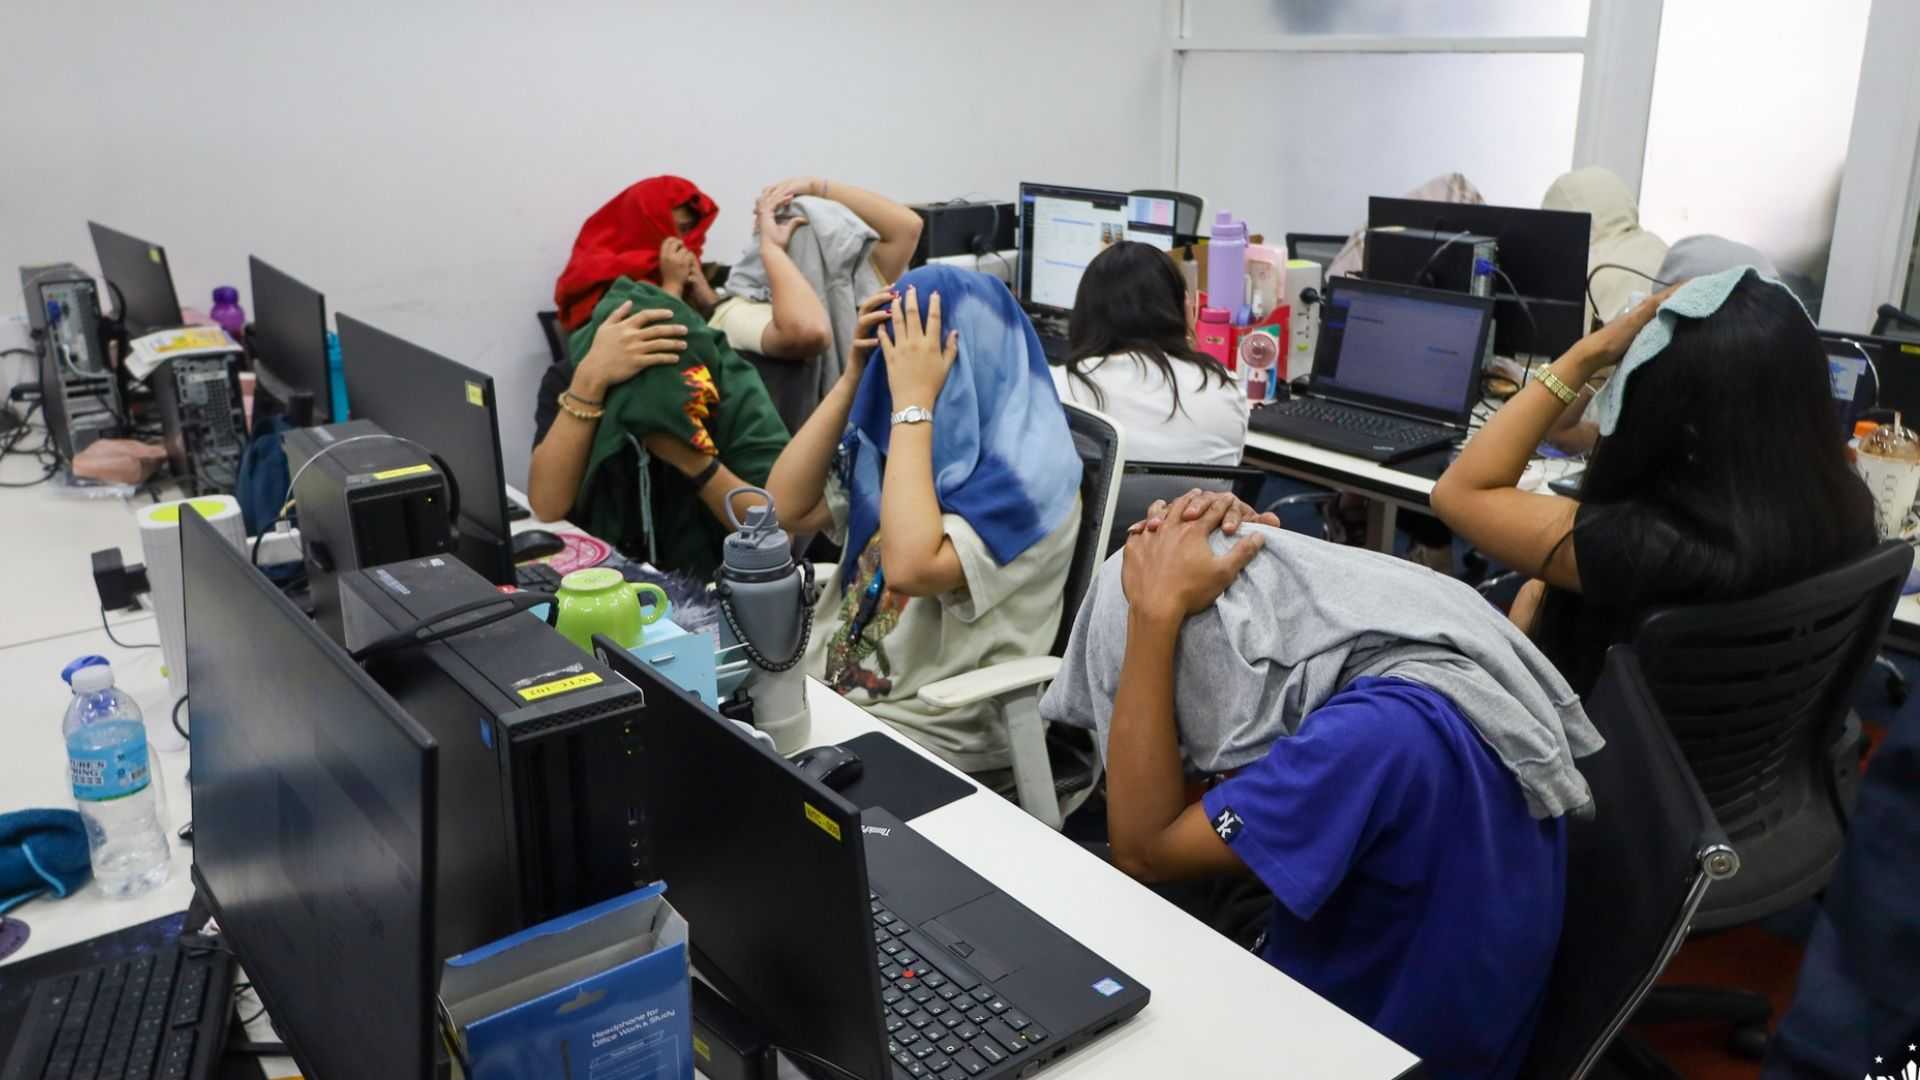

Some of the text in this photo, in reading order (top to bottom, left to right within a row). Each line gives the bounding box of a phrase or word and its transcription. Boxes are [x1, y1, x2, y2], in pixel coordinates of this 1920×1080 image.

[592, 1007, 660, 1040] Headphone for
[592, 1033, 618, 1048] Office
[618, 1023, 642, 1037] Work
[649, 1008, 676, 1025] Study
